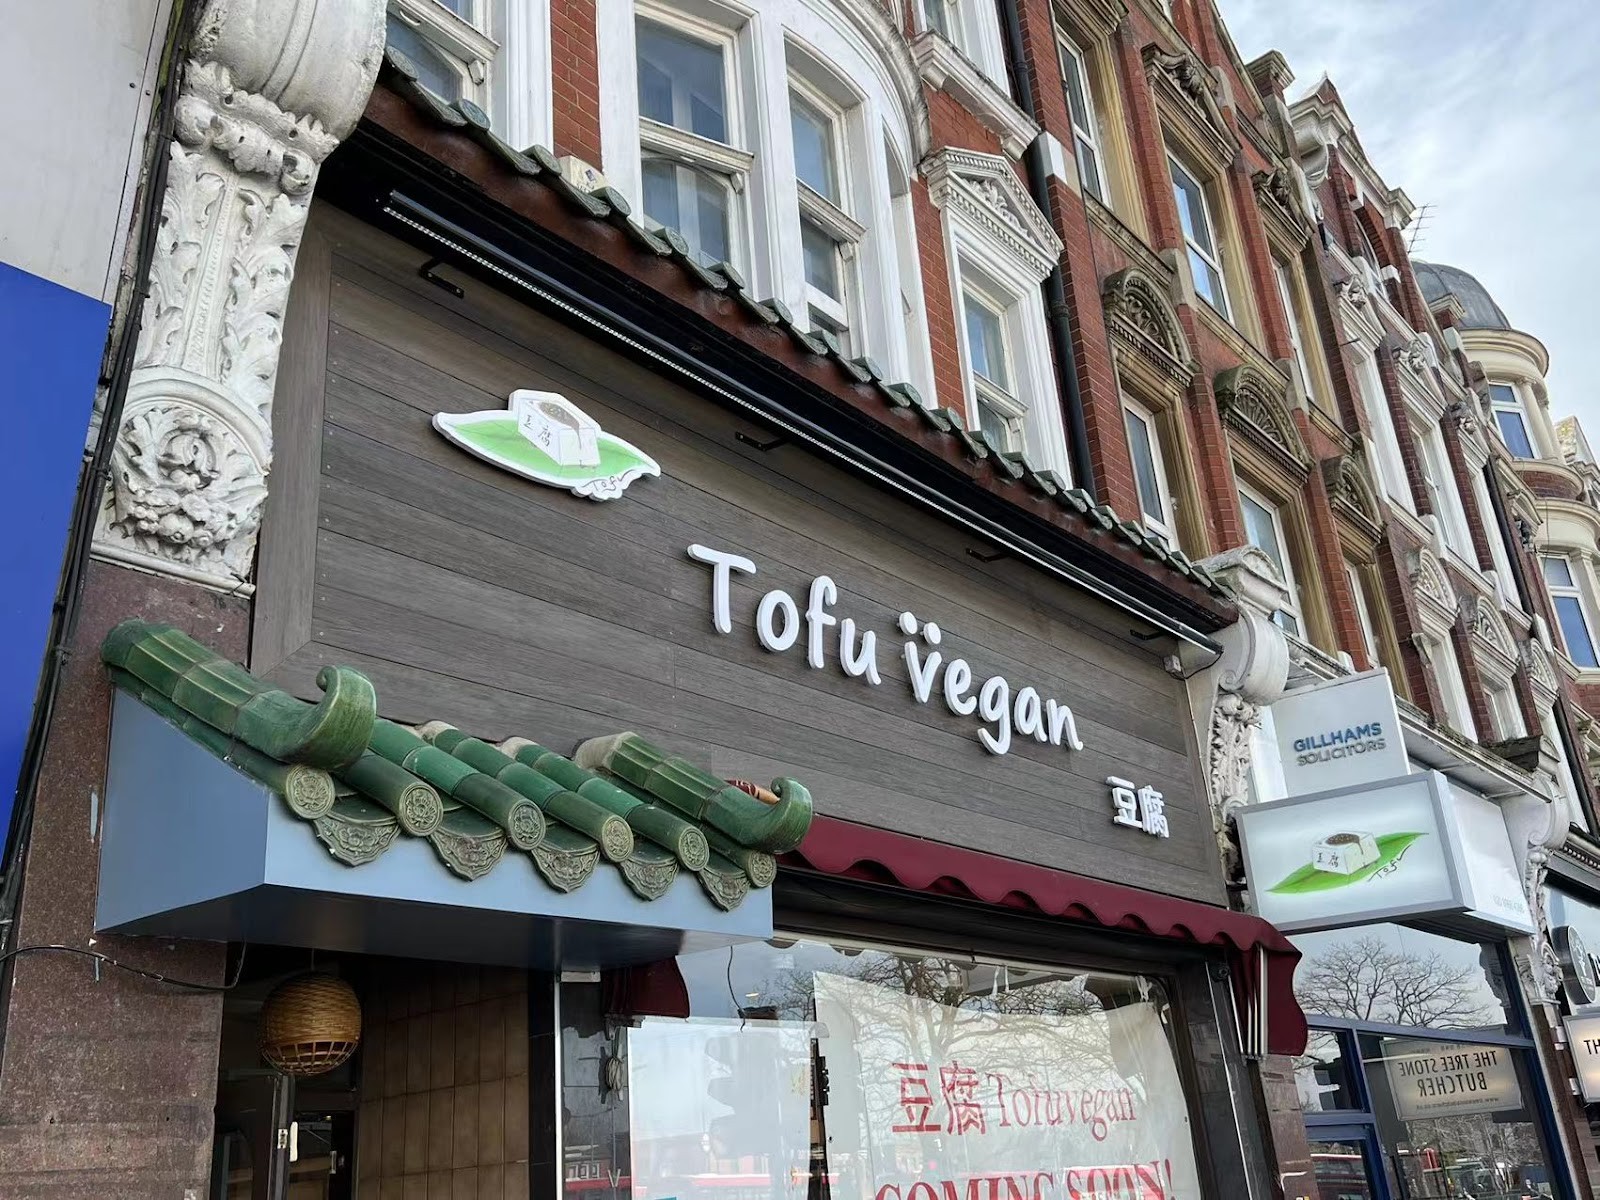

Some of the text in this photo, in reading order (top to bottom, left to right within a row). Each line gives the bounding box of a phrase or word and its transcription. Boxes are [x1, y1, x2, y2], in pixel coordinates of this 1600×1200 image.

[582, 467, 636, 493] Tofu
[685, 543, 882, 686] Tofu
[1293, 722, 1383, 752] GILLHAMS
[1297, 738, 1387, 766] SOLICITORS
[1106, 776, 1170, 839] 豆腐
[1367, 843, 1413, 882] Tofu
[891, 1060, 1137, 1141] 豆腐 Tofuvegan
